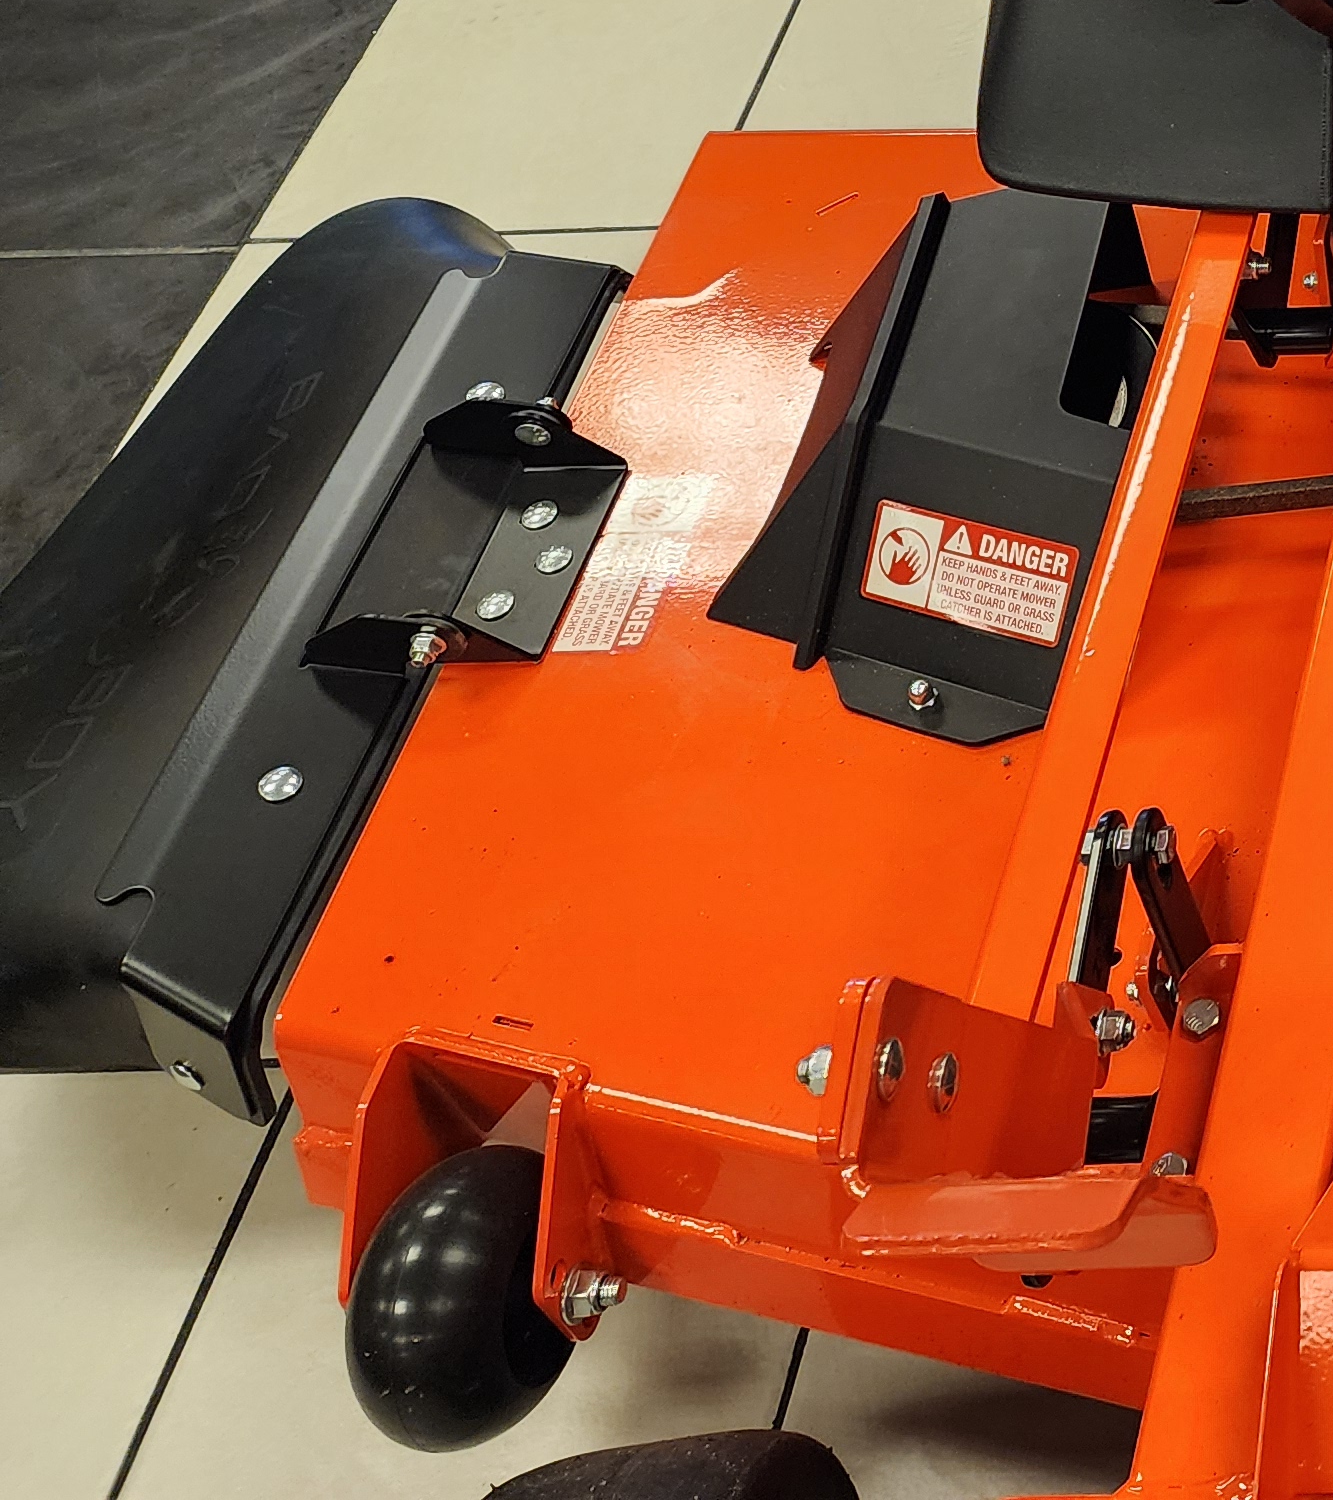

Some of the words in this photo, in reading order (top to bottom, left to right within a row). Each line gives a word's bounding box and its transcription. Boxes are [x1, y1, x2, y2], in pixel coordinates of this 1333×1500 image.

[979, 534, 1069, 577] DANGER
[941, 556, 964, 570] KEEP
[966, 563, 998, 580] HANDS
[1000, 572, 1008, 582] &
[1009, 574, 1031, 589] FEET
[1033, 580, 1061, 596] AWAY.
[941, 571, 953, 583] DO
[956, 575, 974, 589] NOT
[977, 581, 1018, 599] OPERATE
[1020, 591, 1056, 610] MOWER
[585, 602, 600, 617] OR
[936, 584, 971, 602] UNLESS
[973, 593, 1005, 610] GUARD
[1008, 602, 1020, 614] OR
[1023, 606, 1055, 623] GRASS
[940, 599, 981, 620] CATCHER
[983, 611, 992, 622] IS
[994, 614, 1044, 635] ATTACHED.
[571, 617, 594, 647] GRASS
[585, 610, 608, 645] MOWER
